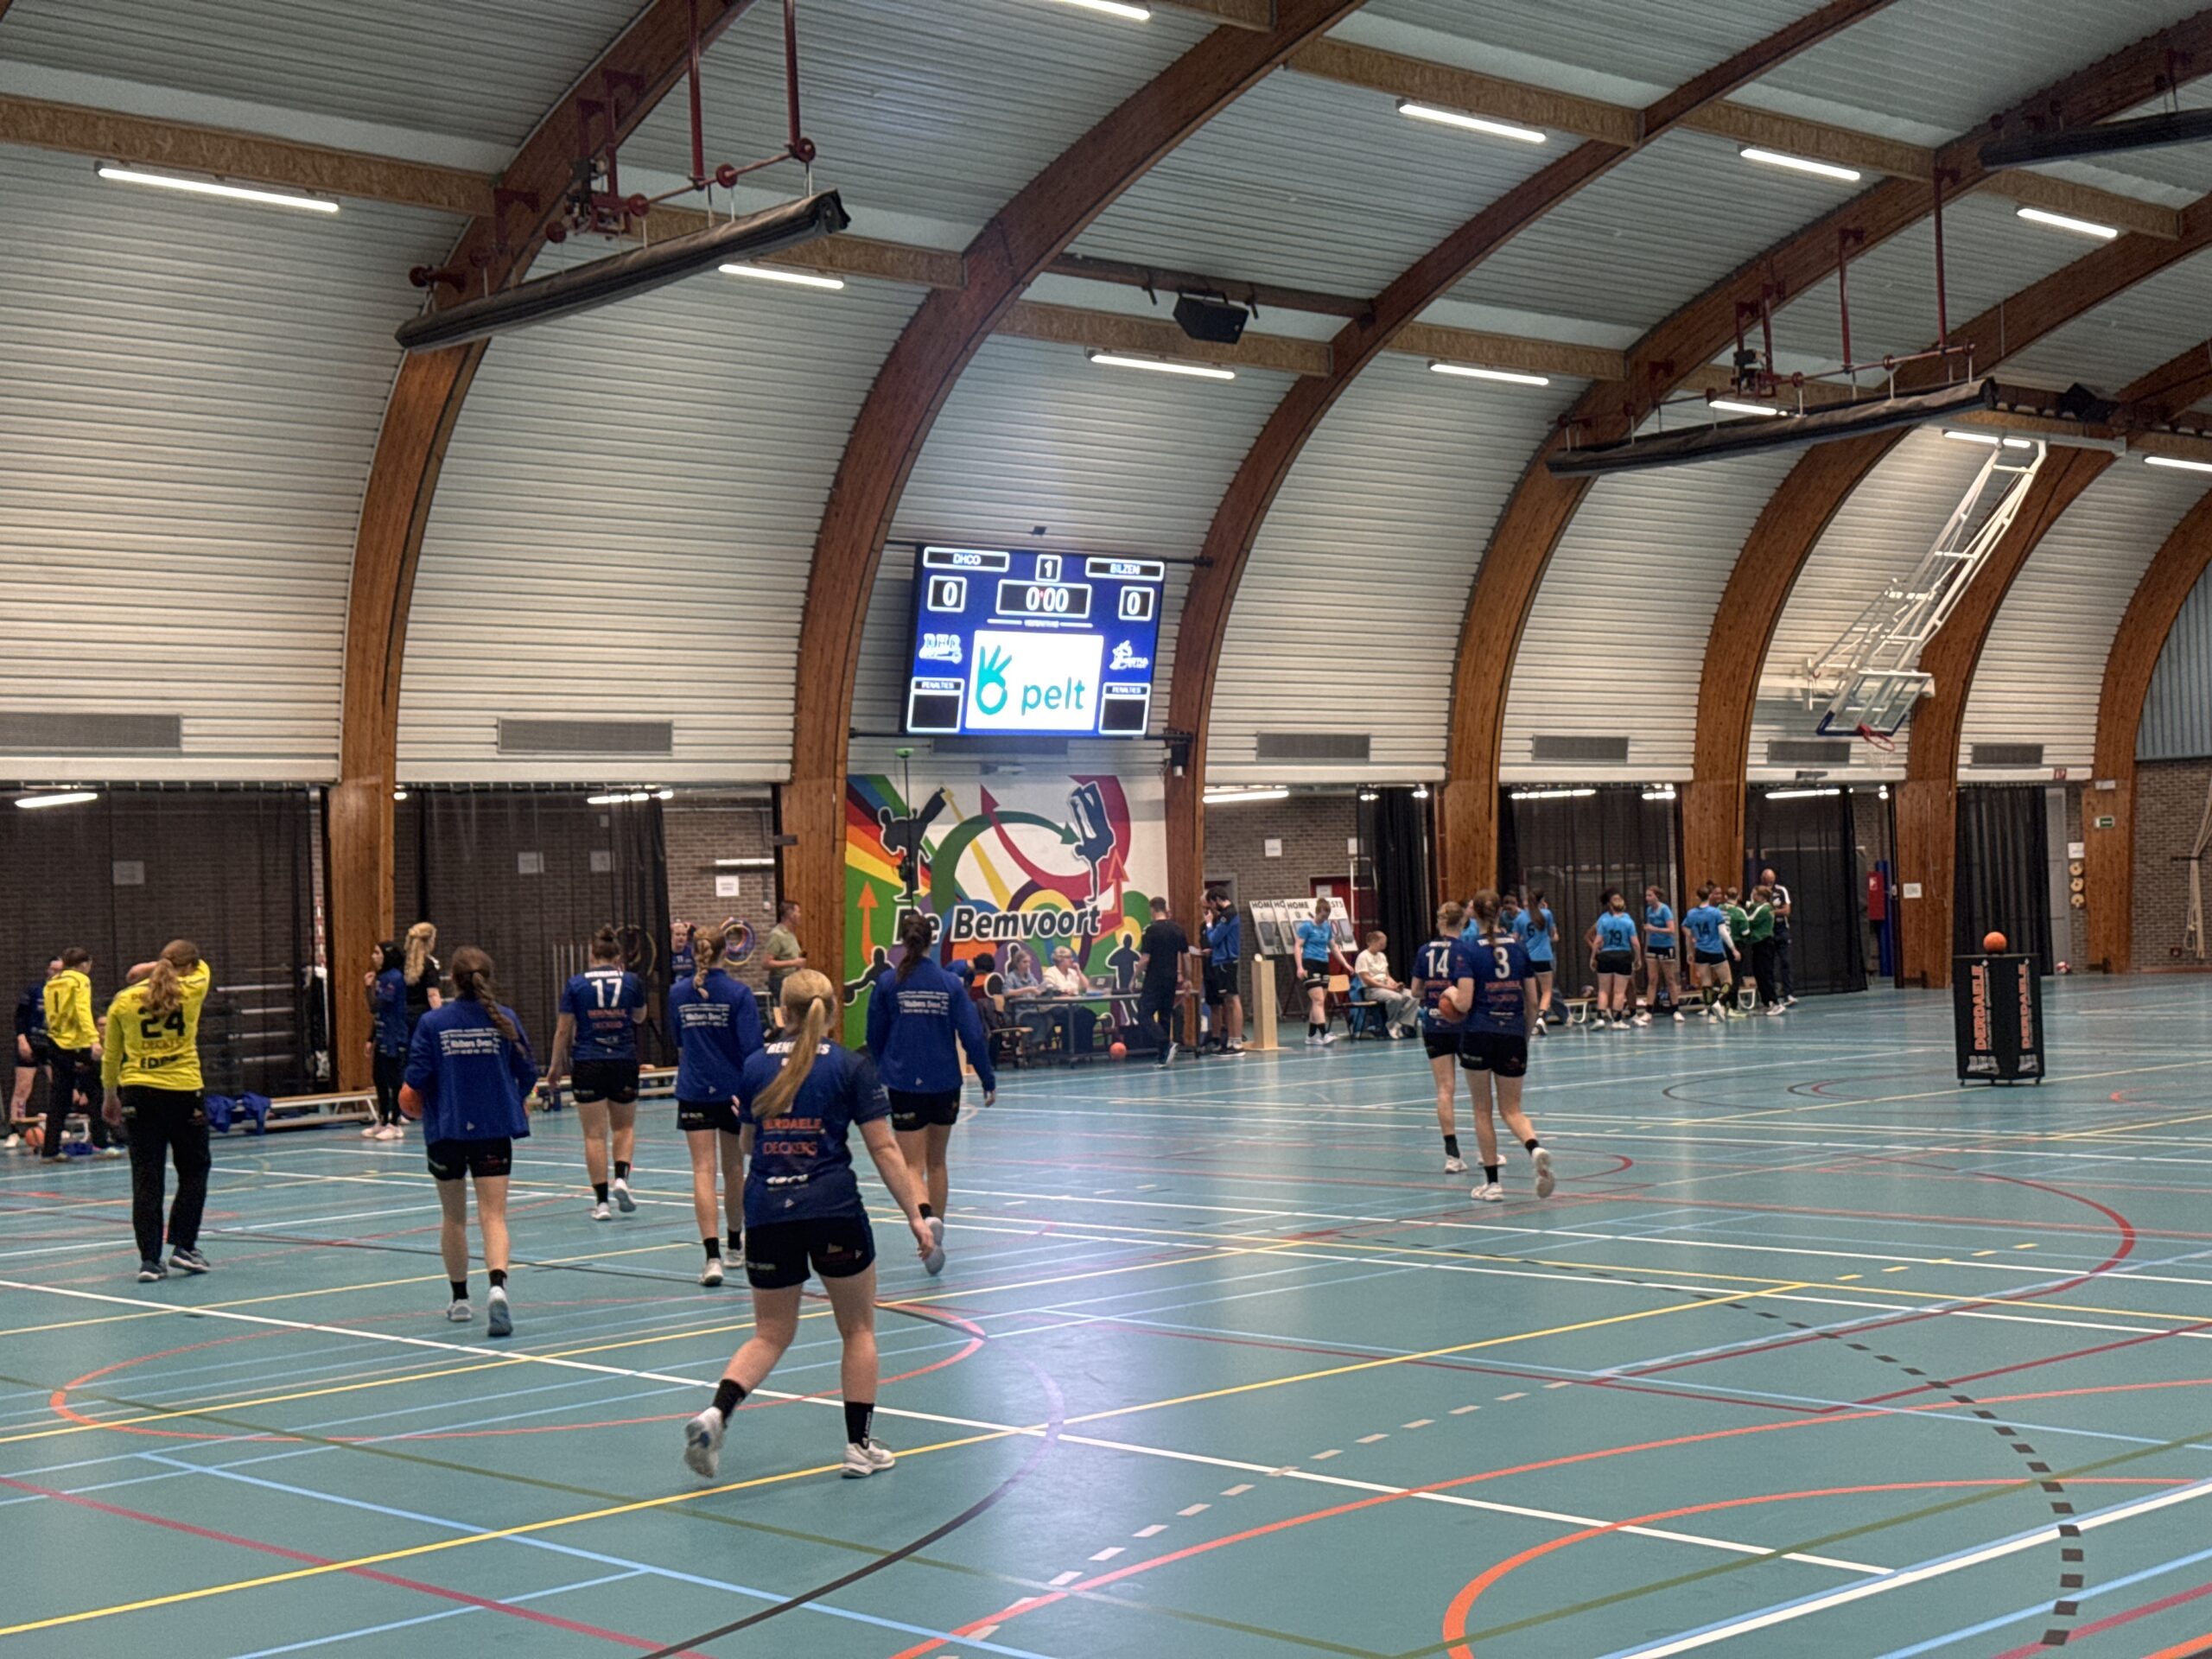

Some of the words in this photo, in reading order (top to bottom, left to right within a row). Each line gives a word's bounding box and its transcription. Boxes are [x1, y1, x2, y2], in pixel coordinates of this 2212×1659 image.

[1044, 560, 1053, 577] 1
[1109, 563, 1141, 575] BILZEN
[943, 582, 957, 606] 0
[1126, 592, 1141, 614] 0
[1021, 677, 1085, 715] pelt
[1251, 900, 1273, 909] HOM
[1287, 901, 1309, 910] HOME
[951, 905, 1100, 941] Bemvoort
[1425, 948, 1449, 978] 14
[1495, 946, 1510, 979] 3
[591, 978, 622, 1007] 17
[137, 1003, 186, 1039] 24
[1971, 965, 1987, 1051] DERDAELE
[763, 1141, 817, 1155] DECKERS
